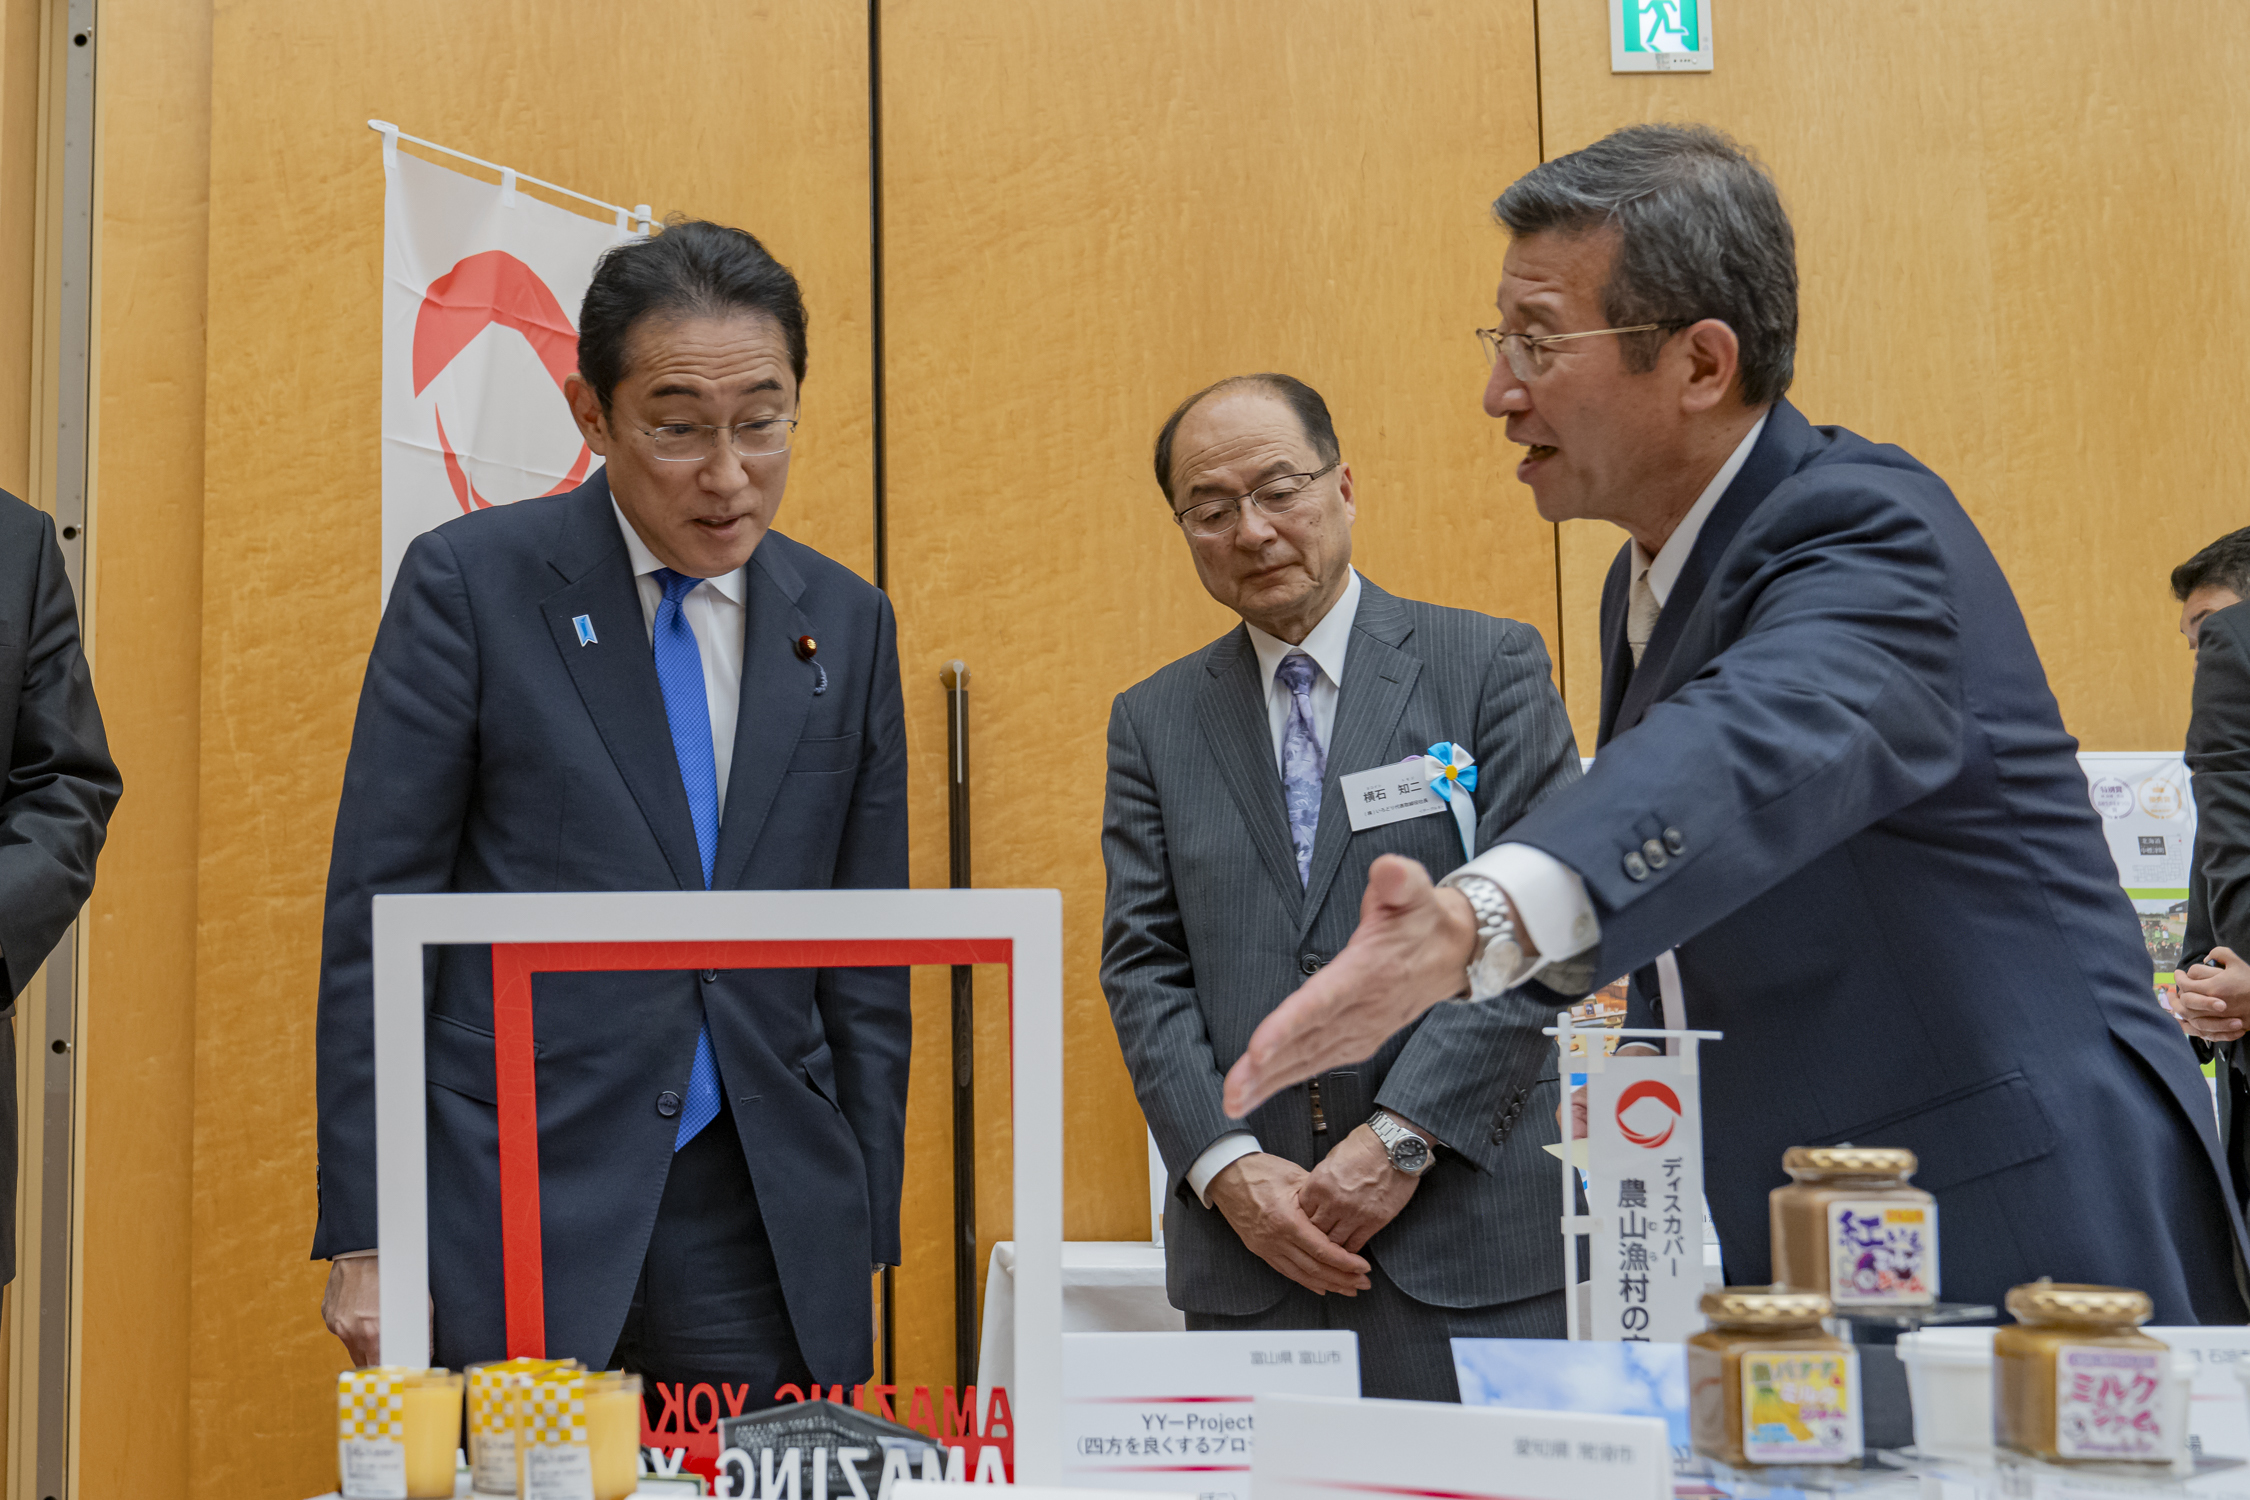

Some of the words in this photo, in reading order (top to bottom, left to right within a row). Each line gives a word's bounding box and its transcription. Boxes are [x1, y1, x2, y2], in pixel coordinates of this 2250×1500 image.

[1363, 788, 1387, 803] 横石
[1397, 781, 1422, 795] 知二
[1662, 1156, 1684, 1277] ディスカバー
[1618, 1178, 1651, 1342] 農山漁村の
[1251, 1350, 1293, 1365] 富山県
[1298, 1350, 1341, 1365] 富山市
[2071, 1372, 2158, 1404] ミルク
[1077, 1435, 1254, 1456] （四方を良くするプロ
